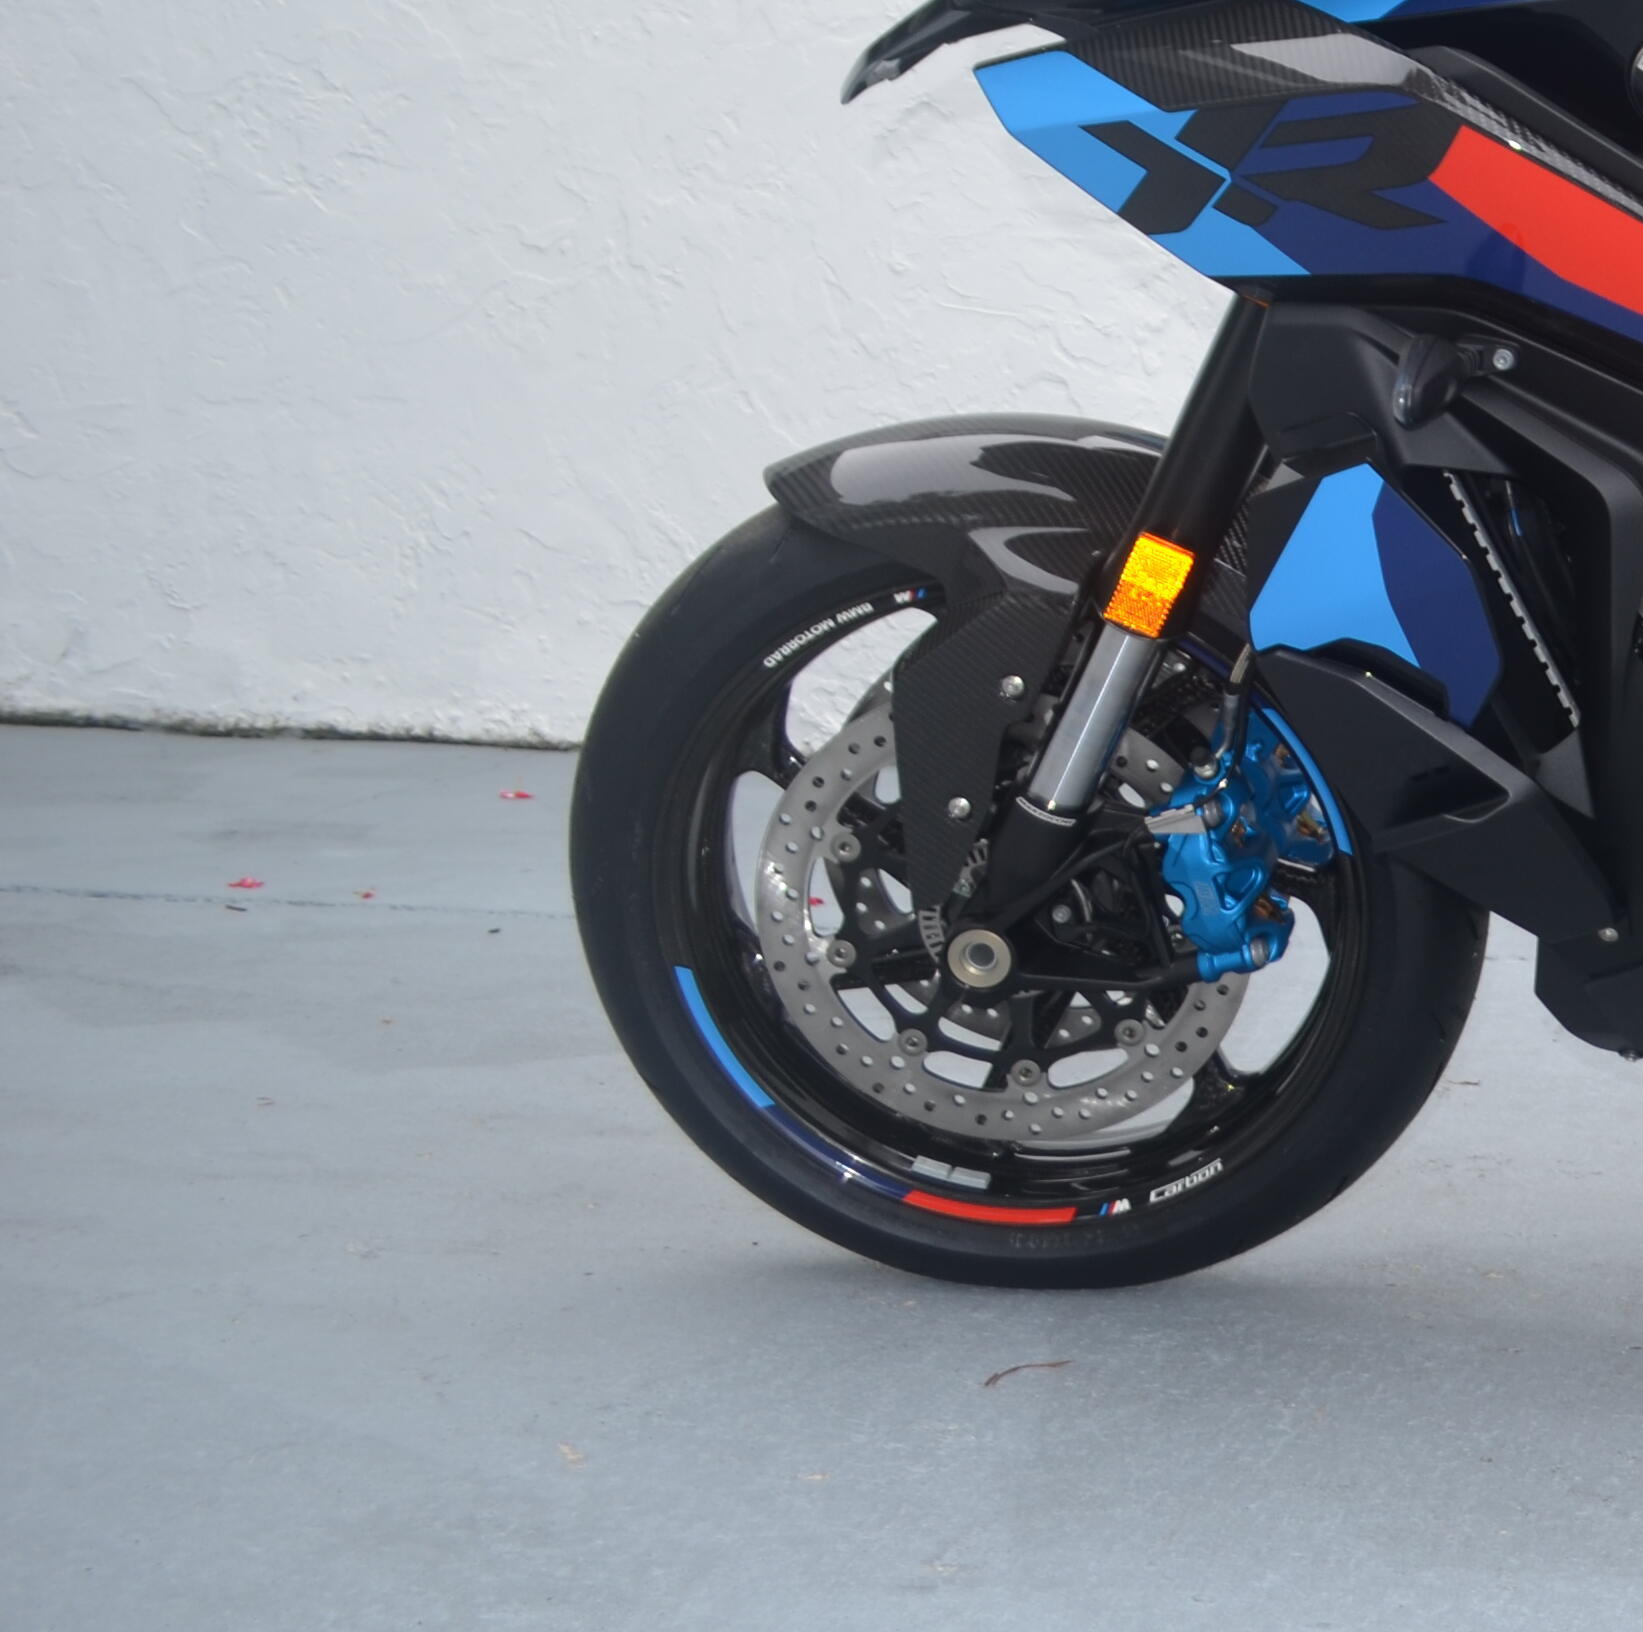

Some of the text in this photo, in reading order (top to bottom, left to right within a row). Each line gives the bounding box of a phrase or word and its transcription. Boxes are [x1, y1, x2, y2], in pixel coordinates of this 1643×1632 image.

[763, 601, 875, 668] BMW MOTORRAD
[1149, 1157, 1224, 1204] Carbon
